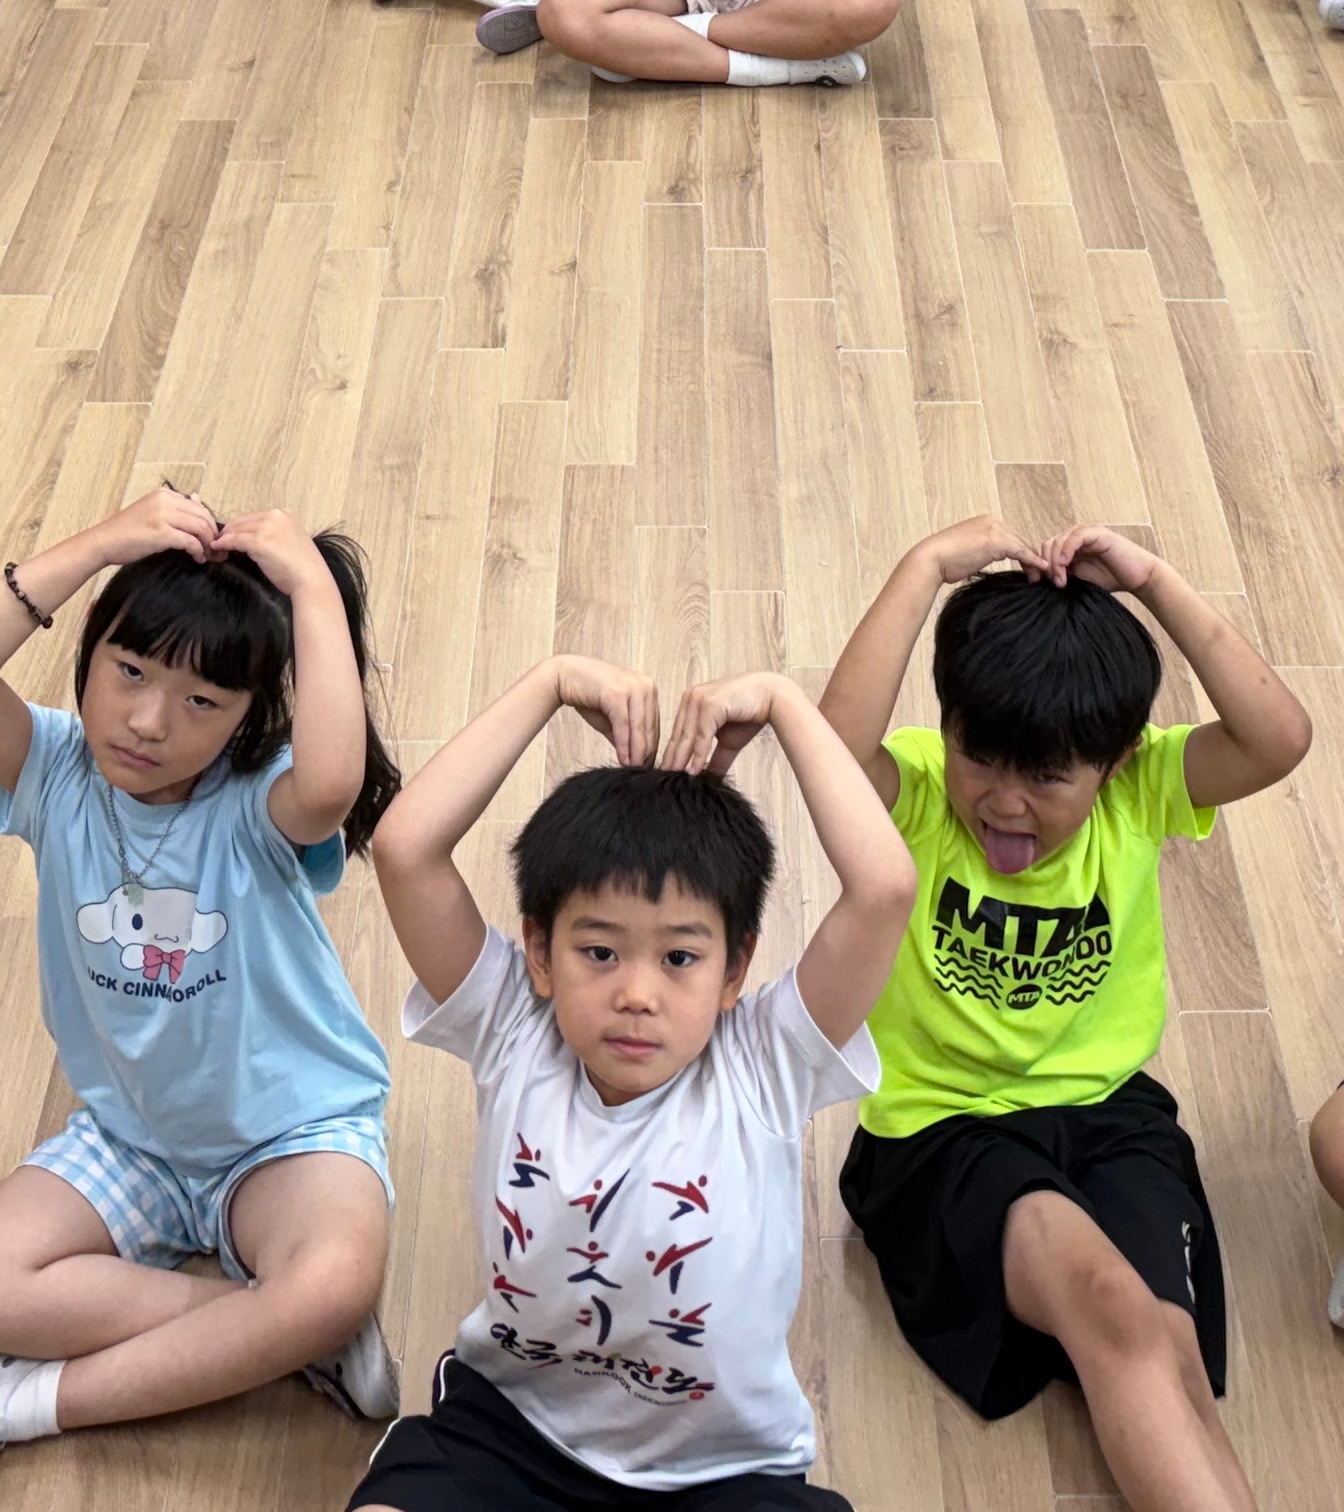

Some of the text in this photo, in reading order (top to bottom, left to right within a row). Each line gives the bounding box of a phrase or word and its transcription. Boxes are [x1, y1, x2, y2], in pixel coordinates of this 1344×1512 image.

[936, 876, 1110, 958] MTA
[932, 925, 1112, 981] TAEKWONDO
[1007, 990, 1042, 1005] MTA
